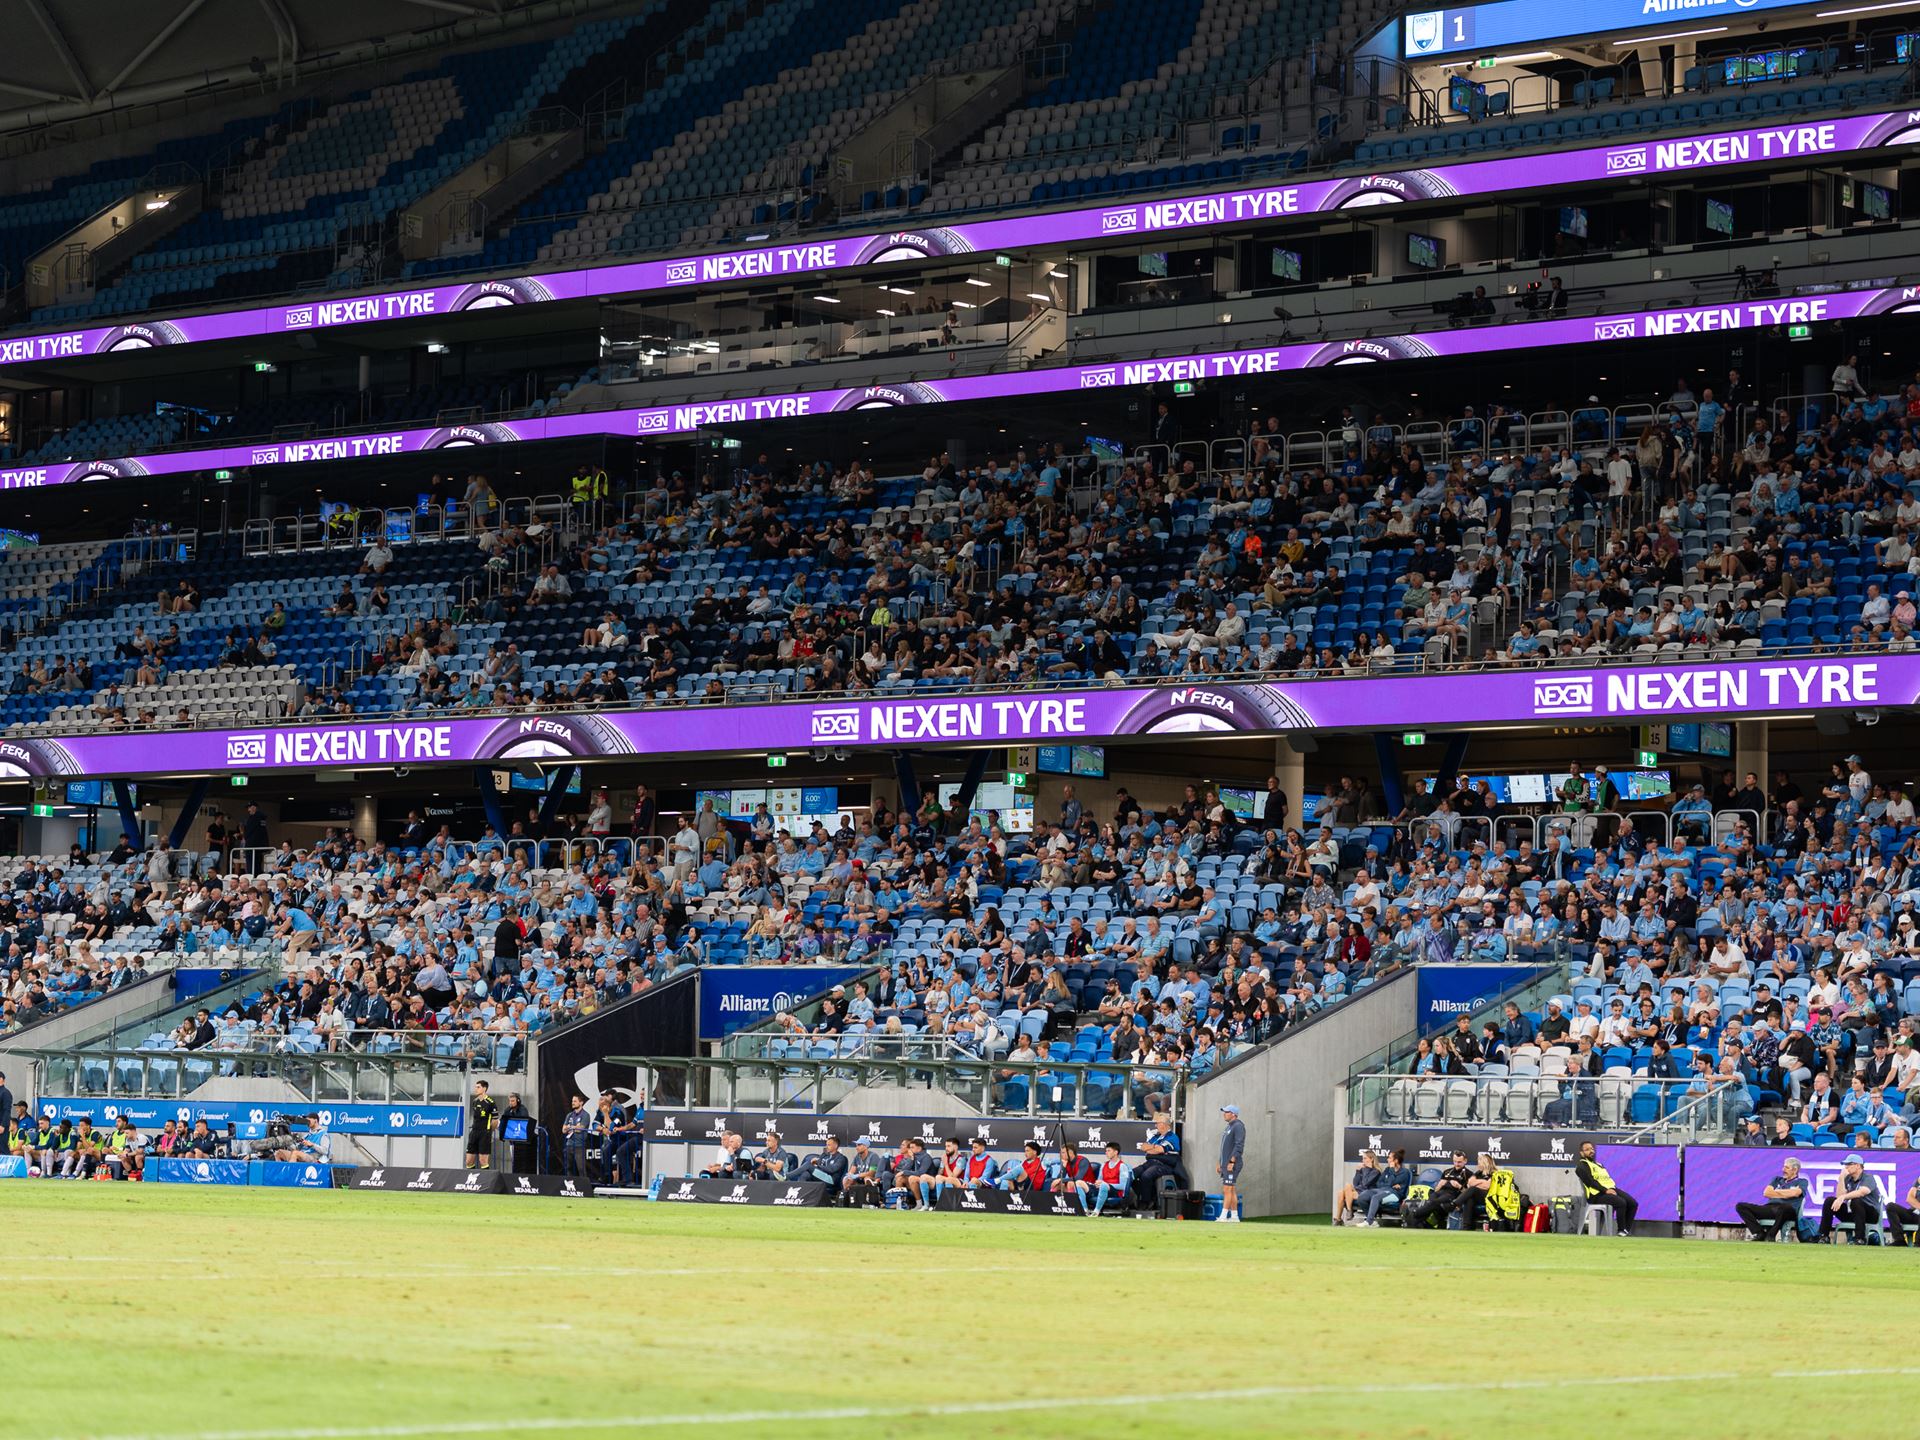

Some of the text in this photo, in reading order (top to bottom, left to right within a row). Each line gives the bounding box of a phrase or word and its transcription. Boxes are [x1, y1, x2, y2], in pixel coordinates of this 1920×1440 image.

[1453, 15, 1465, 42] 1
[1655, 124, 1835, 170] NEXEN TYRE
[1607, 151, 1646, 170] NEXEN
[1145, 189, 1298, 229] NEXEN TYRE
[1103, 212, 1136, 229] NEXEN
[703, 244, 836, 280] NEXEN TYRE
[666, 265, 696, 280] NEXEN
[318, 292, 435, 325] NEXEN TYRE
[286, 310, 312, 325] NEXEN
[1645, 299, 1827, 336] NEXEN TYRE
[1594, 323, 1635, 340] NEXEN
[0, 335, 83, 362] XEN TYRE
[1124, 351, 1280, 385] NEXEN TYRE
[1081, 372, 1115, 387] NEXEN
[675, 396, 810, 430] NEXEN TYRE
[638, 414, 668, 429] NEXEN
[284, 435, 403, 463] NEXEN TYRE
[252, 452, 279, 465] NEXEN
[2, 469, 47, 488] TYRE
[1534, 684, 1592, 706] NEXEN
[1607, 663, 1878, 712] NEXEN TYRE
[812, 714, 859, 735] NEXEN
[871, 698, 1085, 740] NEXEN TYRE
[275, 726, 450, 763] NEXEN TYRE
[1651, 733, 1660, 745] 15
[0, 742, 30, 763] FERA
[228, 741, 265, 758] NEXEN
[1019, 756, 1029, 767] 14
[1518, 805, 1540, 816] THE
[720, 994, 770, 1012] Allianz
[1430, 999, 1471, 1013] Allianz
[43, 1104, 57, 1119] 10
[104, 1105, 118, 1120] 10
[177, 1107, 190, 1122] 10
[249, 1109, 264, 1124] 10
[318, 1110, 332, 1125] 10
[389, 1112, 405, 1128] 10
[968, 1137, 998, 1146] SLEY
[1078, 1140, 1110, 1149] STANLE
[1358, 1149, 1390, 1157] SNLEY
[1419, 1150, 1452, 1159] STANLEY
[1540, 1152, 1574, 1161] STANLEY
[454, 1183, 482, 1191] STANLEY
[560, 1189, 584, 1197] STANLEY
[667, 1193, 697, 1201] STANLEY
[720, 1195, 749, 1203] STANLEY
[773, 1197, 804, 1205] STANLEY
[961, 1201, 986, 1209] STANLEY
